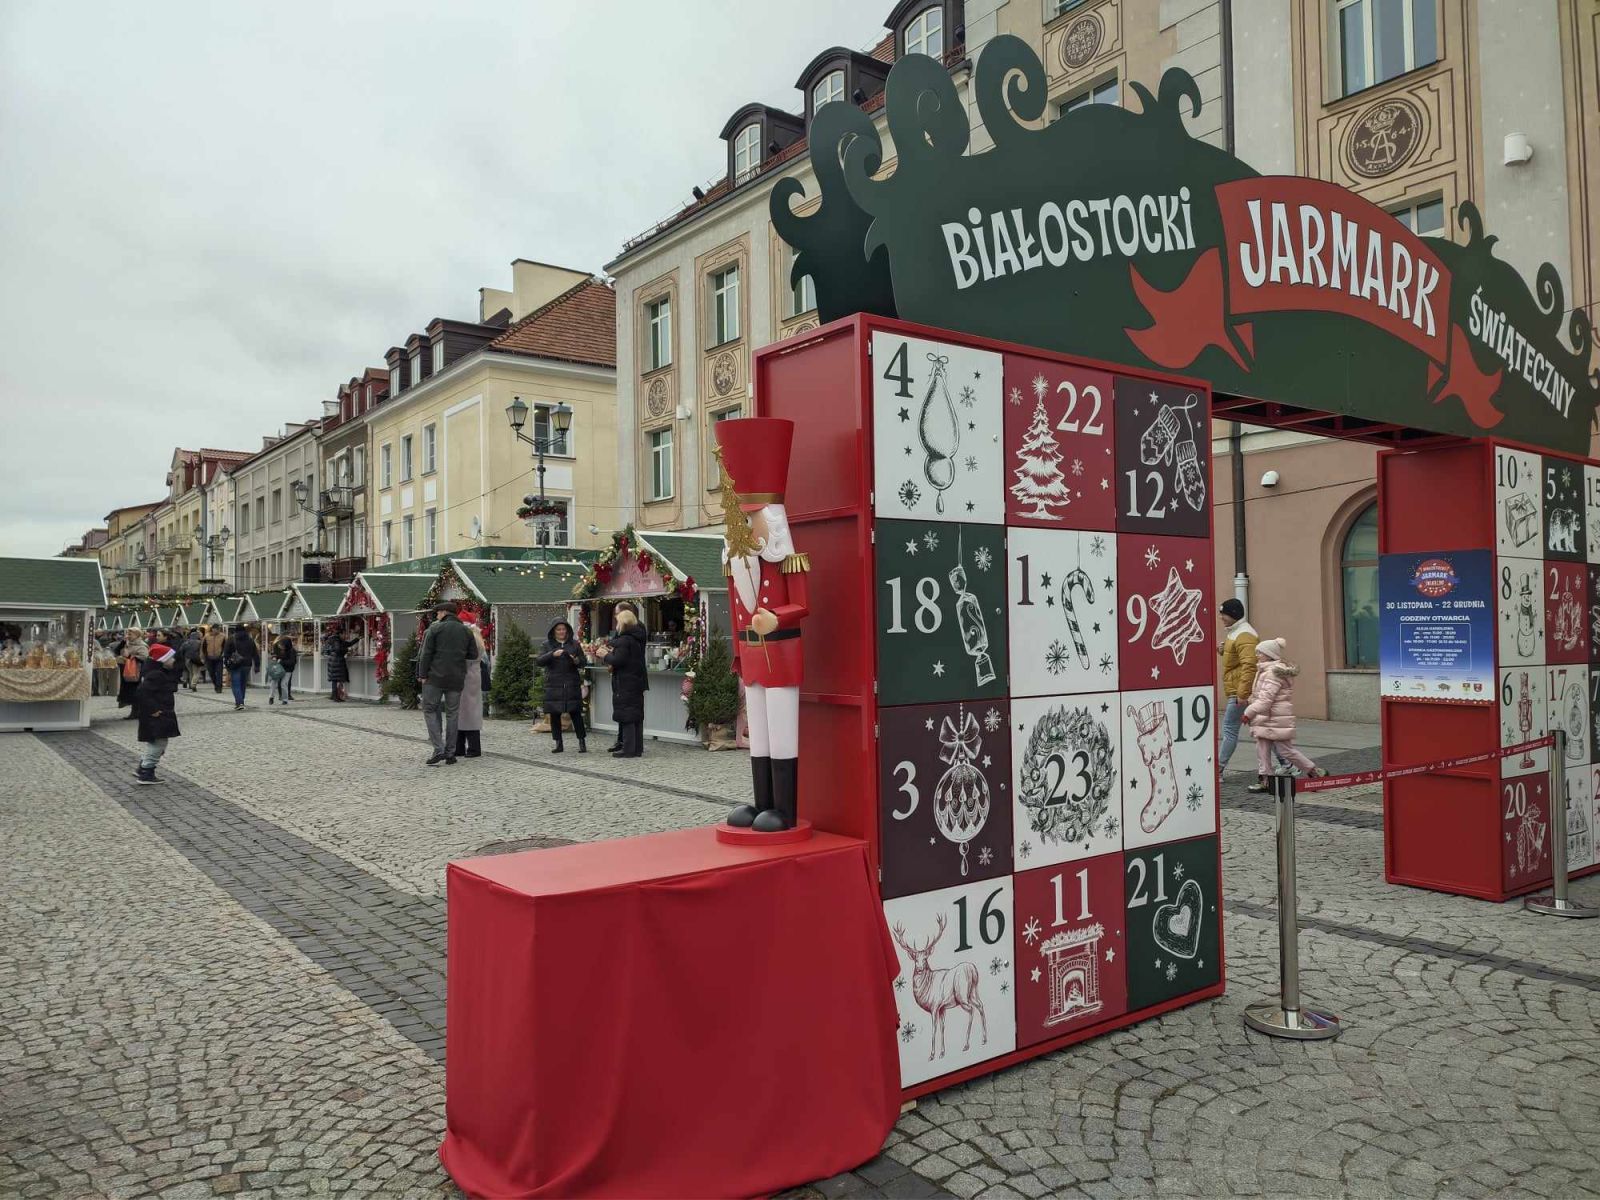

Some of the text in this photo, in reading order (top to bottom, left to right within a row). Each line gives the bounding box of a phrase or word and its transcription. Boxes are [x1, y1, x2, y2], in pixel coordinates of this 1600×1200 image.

[1240, 199, 1440, 337] JARMARK
[883, 341, 914, 398] 4
[1056, 380, 1104, 436] 22
[1125, 469, 1166, 519] 12
[1497, 453, 1518, 489] 10
[1546, 468, 1556, 500] 5
[1016, 554, 1034, 606] 1
[1421, 571, 1448, 580] JARMARK
[1501, 566, 1512, 600] 8
[1549, 567, 1560, 600] 2
[886, 576, 943, 634] 18
[1126, 594, 1147, 643] 9
[1397, 601, 1433, 609] LISTOPADA
[1453, 600, 1485, 608] GRUDNIA
[1502, 671, 1513, 707] 6
[1549, 669, 1567, 702] 17
[1173, 694, 1211, 743] 19
[892, 760, 920, 821] 3
[1044, 750, 1092, 808] 23
[1504, 782, 1527, 819] 20
[1049, 867, 1093, 928] 11
[1127, 853, 1169, 909] 21
[952, 887, 1005, 953] 16
